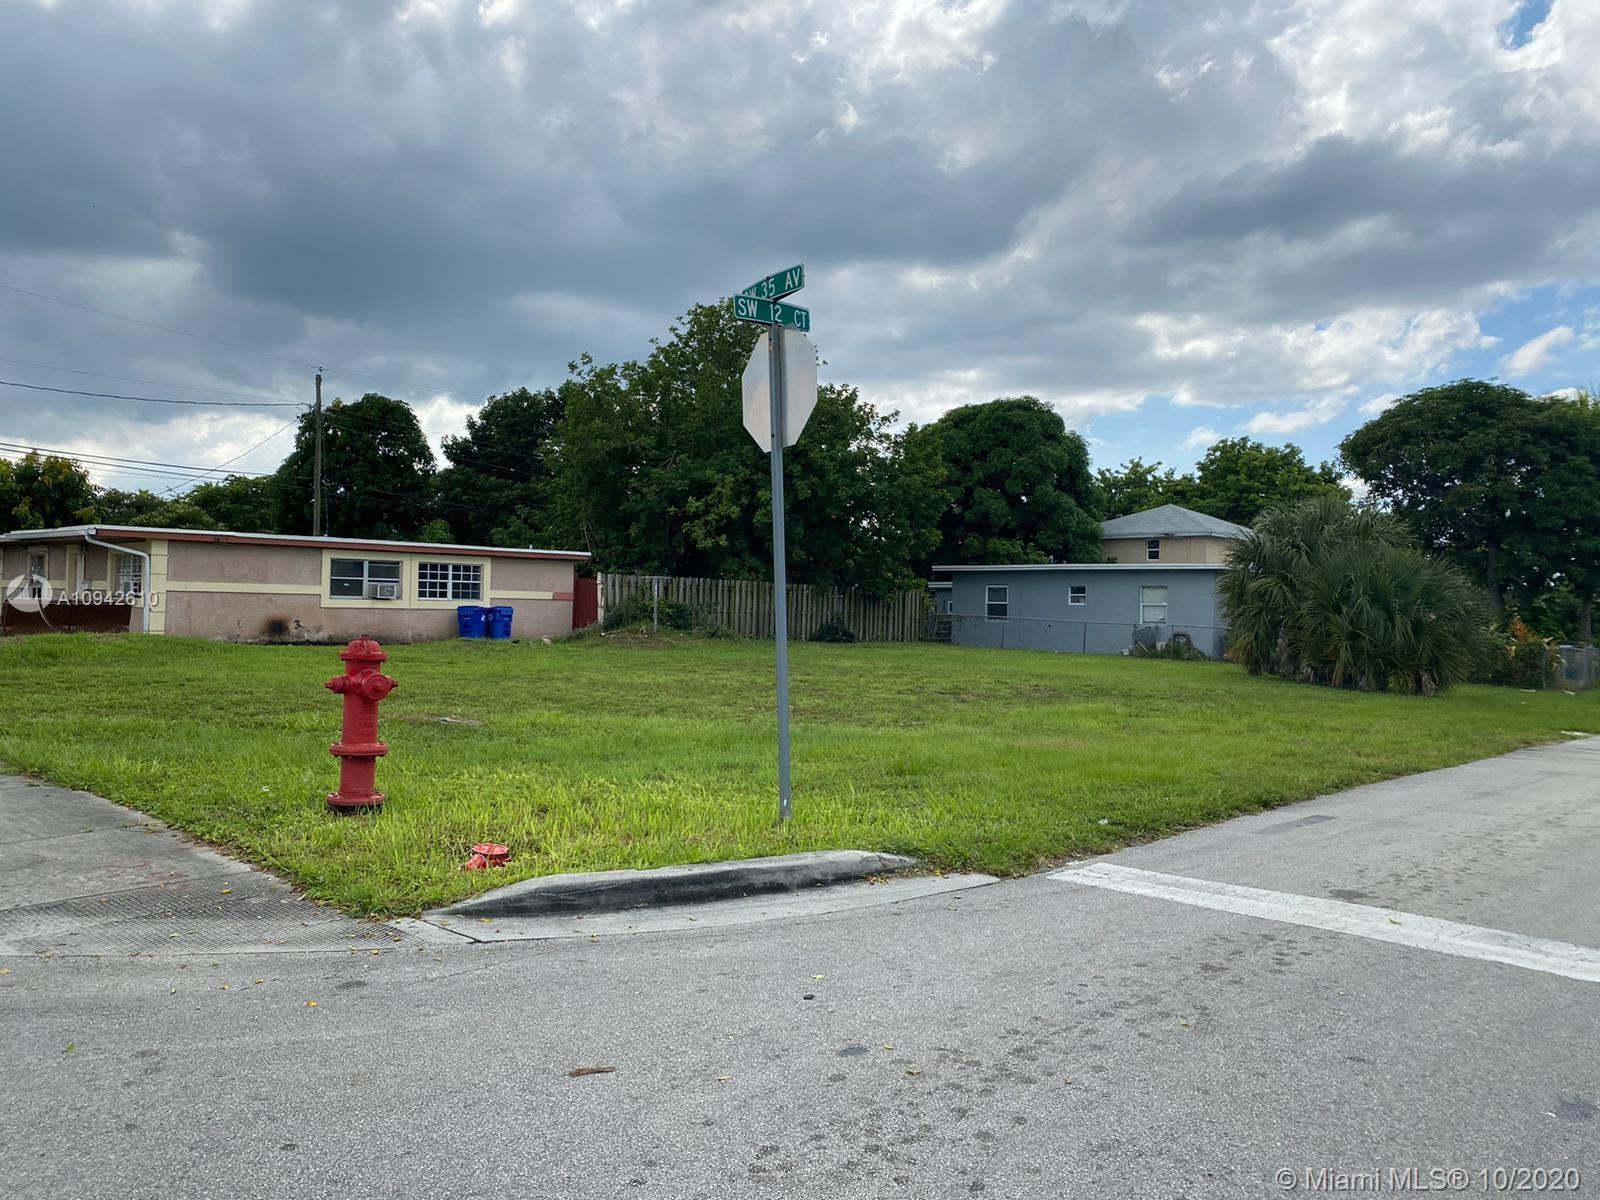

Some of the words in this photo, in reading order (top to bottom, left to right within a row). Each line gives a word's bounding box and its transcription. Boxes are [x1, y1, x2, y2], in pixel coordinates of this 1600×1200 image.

[761, 278, 775, 298] 35
[785, 268, 800, 290] AV
[738, 298, 757, 317] SW
[769, 304, 782, 322] 12
[794, 310, 807, 328] CT
